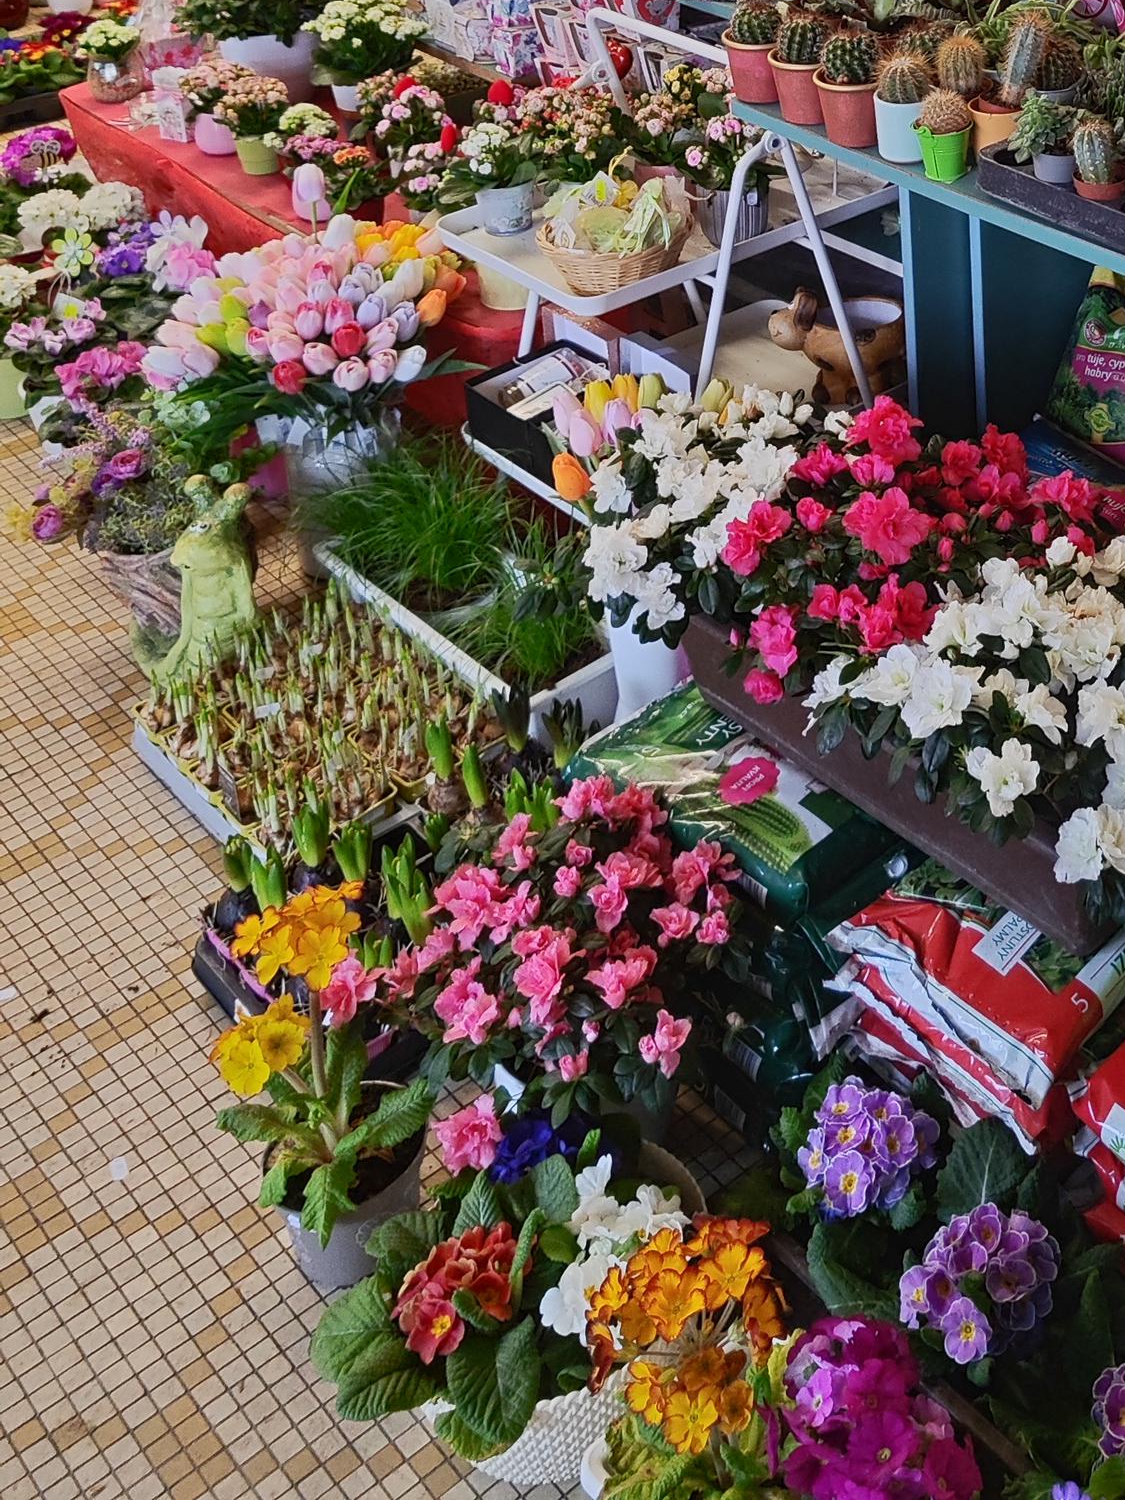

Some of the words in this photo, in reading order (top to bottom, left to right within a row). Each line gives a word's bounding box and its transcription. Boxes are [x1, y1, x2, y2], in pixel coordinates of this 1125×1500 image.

[1087, 353, 1106, 367] túje,
[1085, 366, 1112, 382] habry
[729, 765, 761, 790] KVALITA
[999, 921, 1034, 961] OSTLINY
[1071, 992, 1089, 1014] 5
